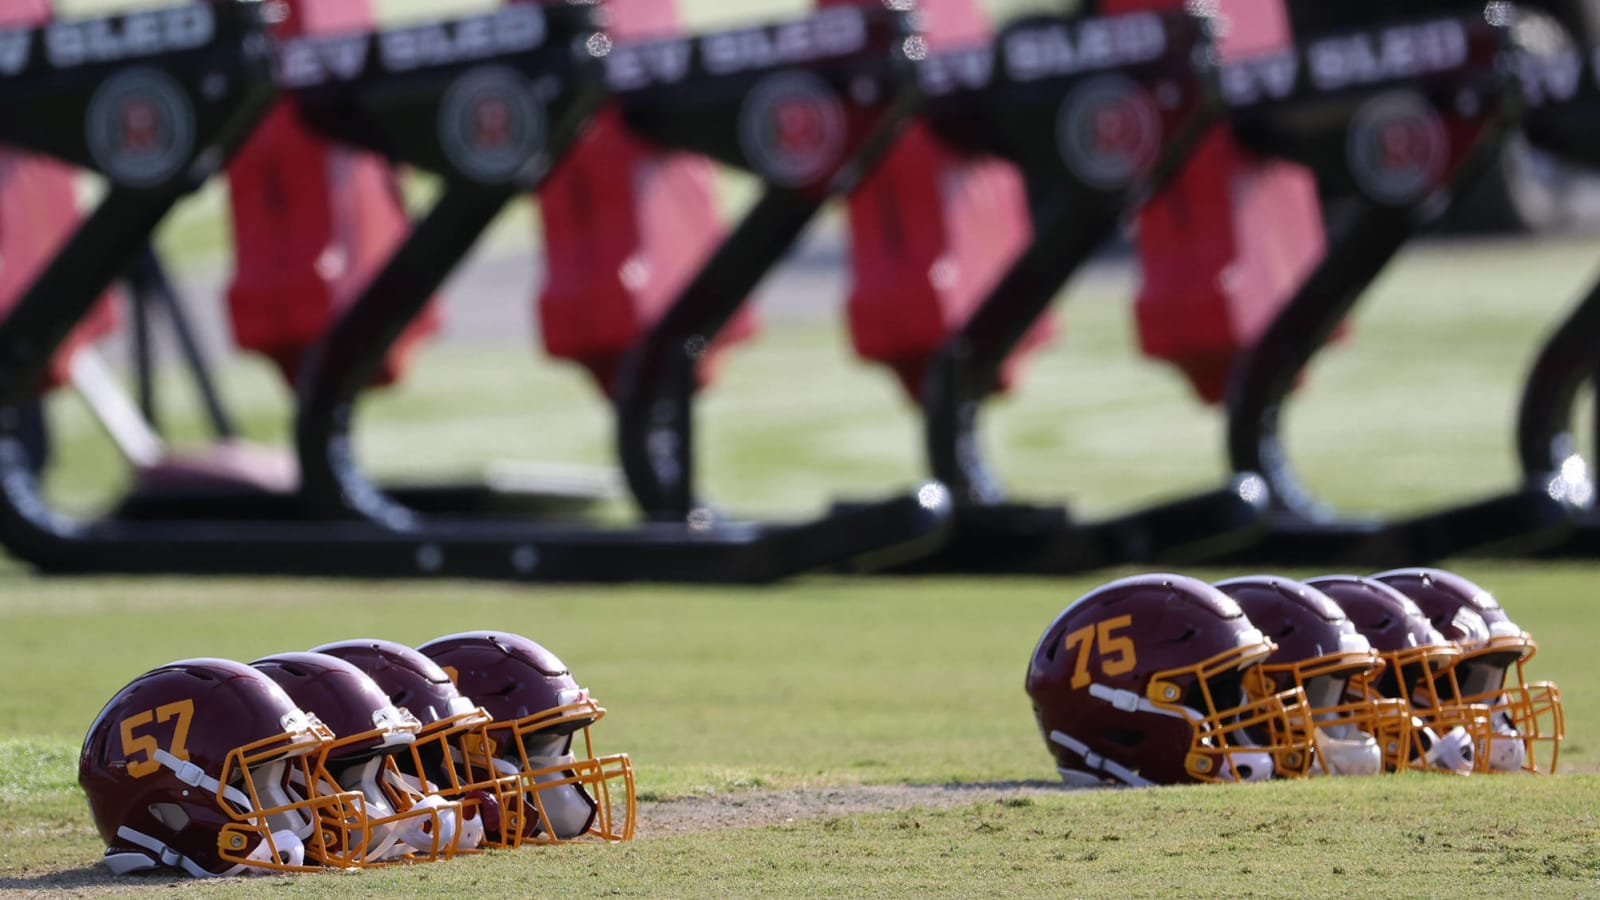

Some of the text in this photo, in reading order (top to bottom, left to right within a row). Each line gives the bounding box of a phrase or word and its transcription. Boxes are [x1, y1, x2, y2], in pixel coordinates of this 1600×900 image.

[46, 5, 215, 67] SLED
[379, 4, 546, 71] SLED
[703, 6, 867, 75] SLED
[1065, 614, 1137, 690] 75
[120, 699, 194, 779] 57
